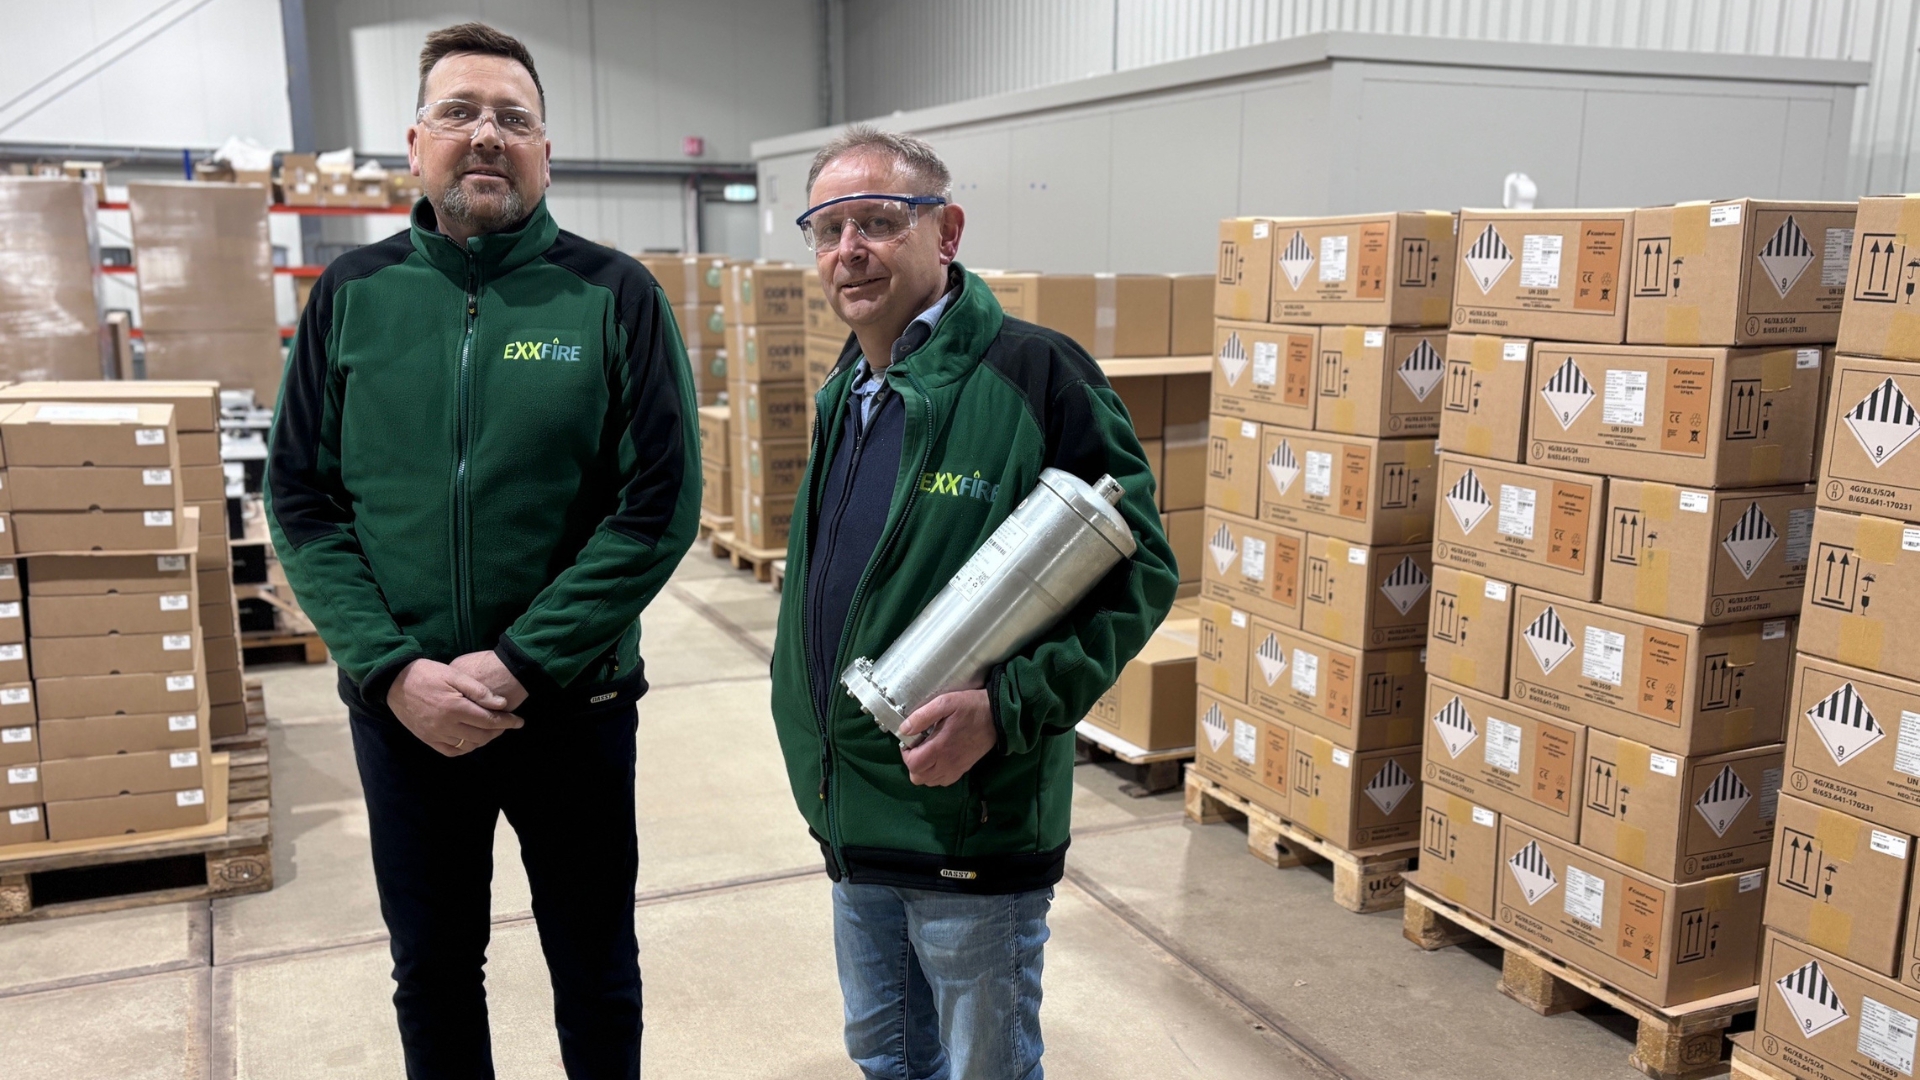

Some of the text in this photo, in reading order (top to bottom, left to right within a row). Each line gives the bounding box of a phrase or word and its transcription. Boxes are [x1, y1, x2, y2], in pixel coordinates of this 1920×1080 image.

[1484, 277, 1489, 287] 9
[1782, 278, 1787, 288] 9
[503, 338, 582, 361] EXXFIRE
[1564, 412, 1569, 422] 9
[1876, 445, 1884, 456] 9
[1850, 485, 1896, 498] 4G/X8.5/S/24
[1848, 494, 1913, 511] B/653.641-170231
[1464, 518, 1469, 527] 9
[1746, 560, 1752, 571] 9
[1544, 658, 1550, 668] 9
[1838, 745, 1844, 756] 9
[1907, 776, 1919, 786] UN
[1814, 778, 1858, 798] 4G/X8.5/S/24
[1812, 787, 1874, 812] B/653.641-170231
[1719, 820, 1724, 830] 9
[942, 870, 968, 878] DASSY
[1528, 888, 1534, 898] 9
[1805, 1018, 1812, 1030] 9
[1783, 1046, 1824, 1070] 4G/X8.5/S/24
[1869, 1060, 1898, 1078] UN 3559
